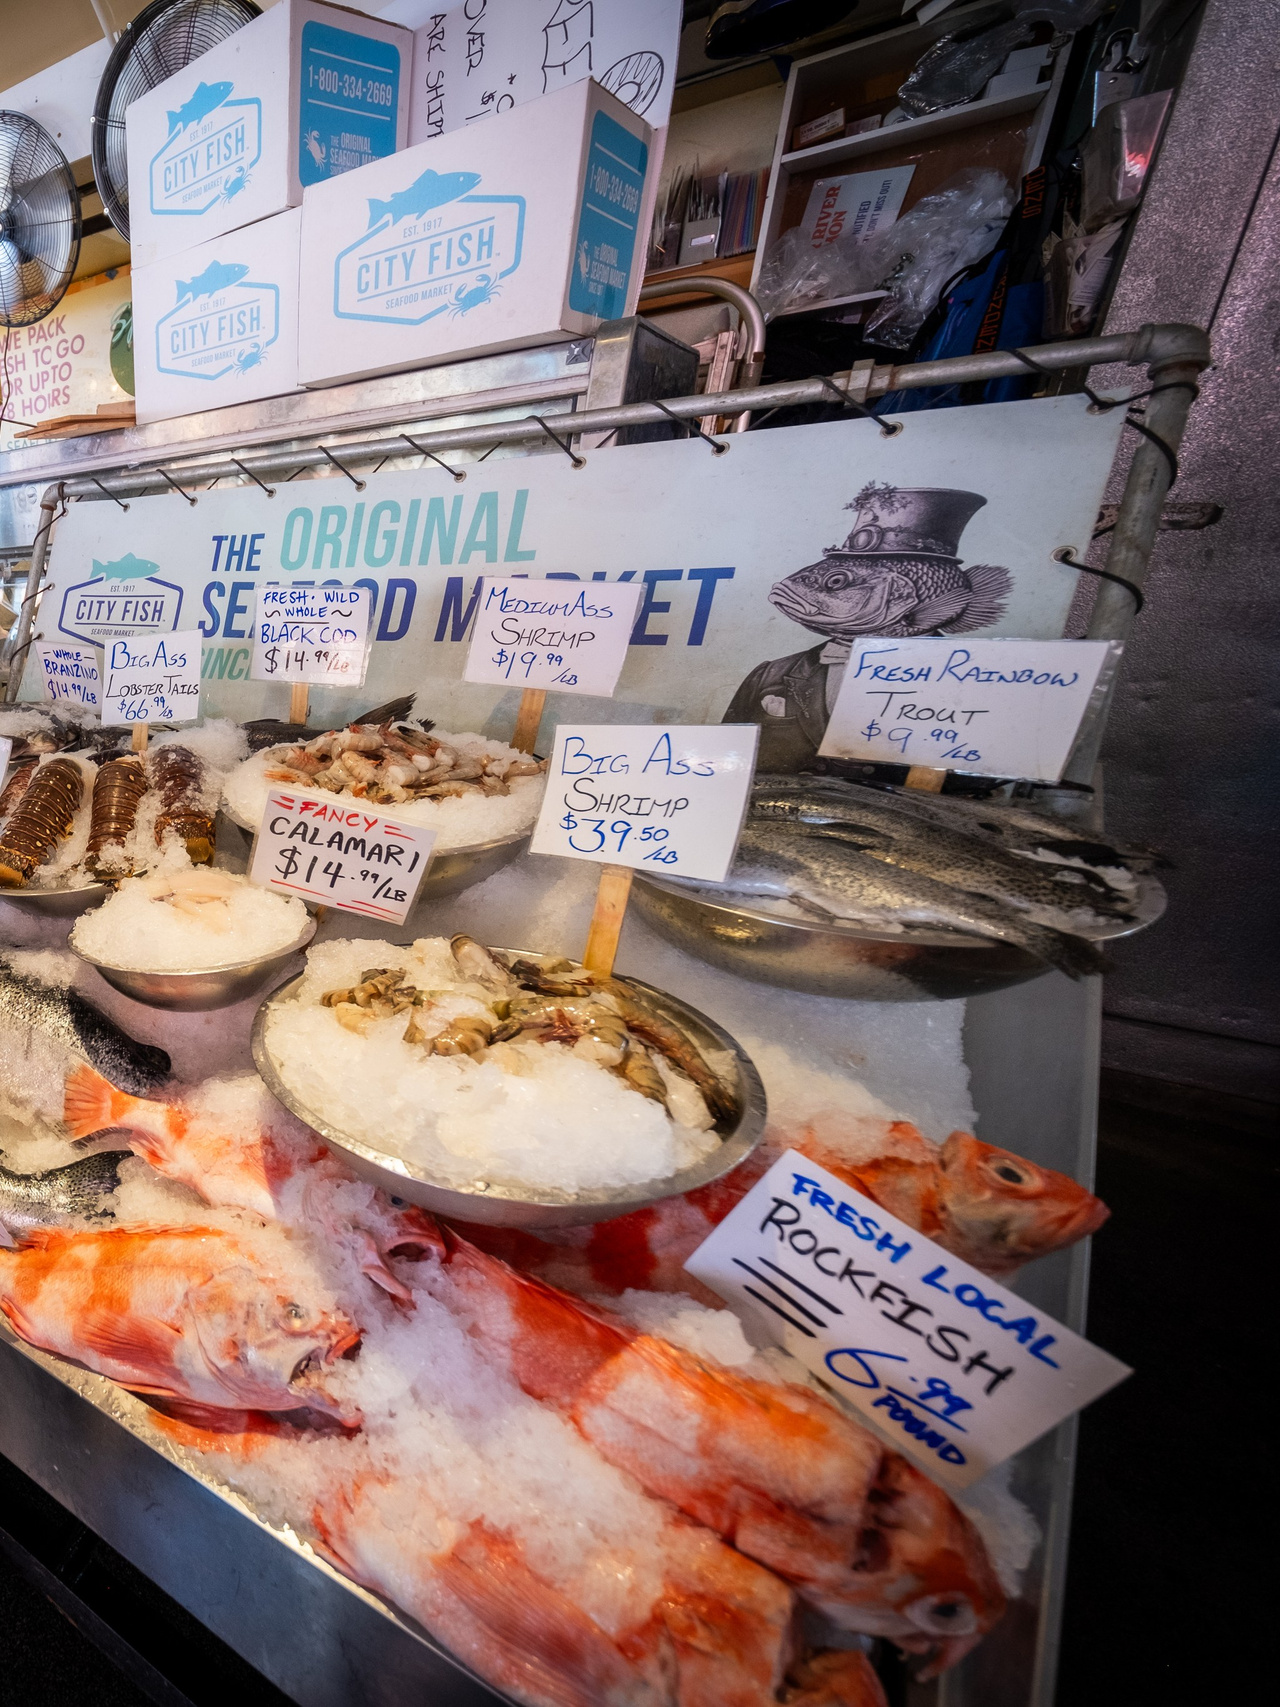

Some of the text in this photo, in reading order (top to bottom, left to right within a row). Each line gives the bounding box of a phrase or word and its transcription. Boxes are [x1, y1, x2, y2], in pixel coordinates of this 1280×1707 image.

[426, 13, 447, 62] ARE
[309, 65, 392, 106] 1-800-334-2669
[330, 132, 372, 153] THE ORIGINAL
[164, 124, 244, 192] CITY FISH
[330, 148, 360, 168] SEAFOOD
[182, 176, 222, 203] SEAFOOD MARKET
[589, 162, 639, 214] 1-800-334-2669
[812, 185, 841, 241] RIVER
[852, 200, 871, 235] NOTIFIED
[874, 195, 887, 212] MISS
[403, 217, 442, 238] EST. 1917
[357, 225, 495, 295] CITY FISH
[385, 283, 454, 310] SEAFOOD MARKET
[28, 315, 66, 345] PACK
[171, 320, 209, 354] CITY
[218, 305, 260, 341] FISH
[56, 334, 85, 359] GO
[191, 348, 236, 367] SEAFOOD MARKET
[1, 361, 72, 399] OR UP TO
[211, 488, 537, 571] THE ORIGINAL
[122, 585, 135, 593] 1917
[325, 591, 360, 604] WILD
[76, 600, 164, 622] CITY FISH
[284, 606, 328, 617] WHOLE
[90, 628, 134, 637] SEAFOOD MARKET
[261, 623, 357, 645] BLACK COD
[43, 659, 98, 680] BRANZINO
[53, 650, 83, 662] WHOLE
[201, 647, 251, 681] INC
[298, 801, 378, 832] FANCY
[269, 816, 420, 873] CALAMARI
[791, 1172, 1060, 1370] FRESH LOCAL
[760, 1196, 1015, 1396] ROCKFISH
[874, 1393, 967, 1467] POUND
